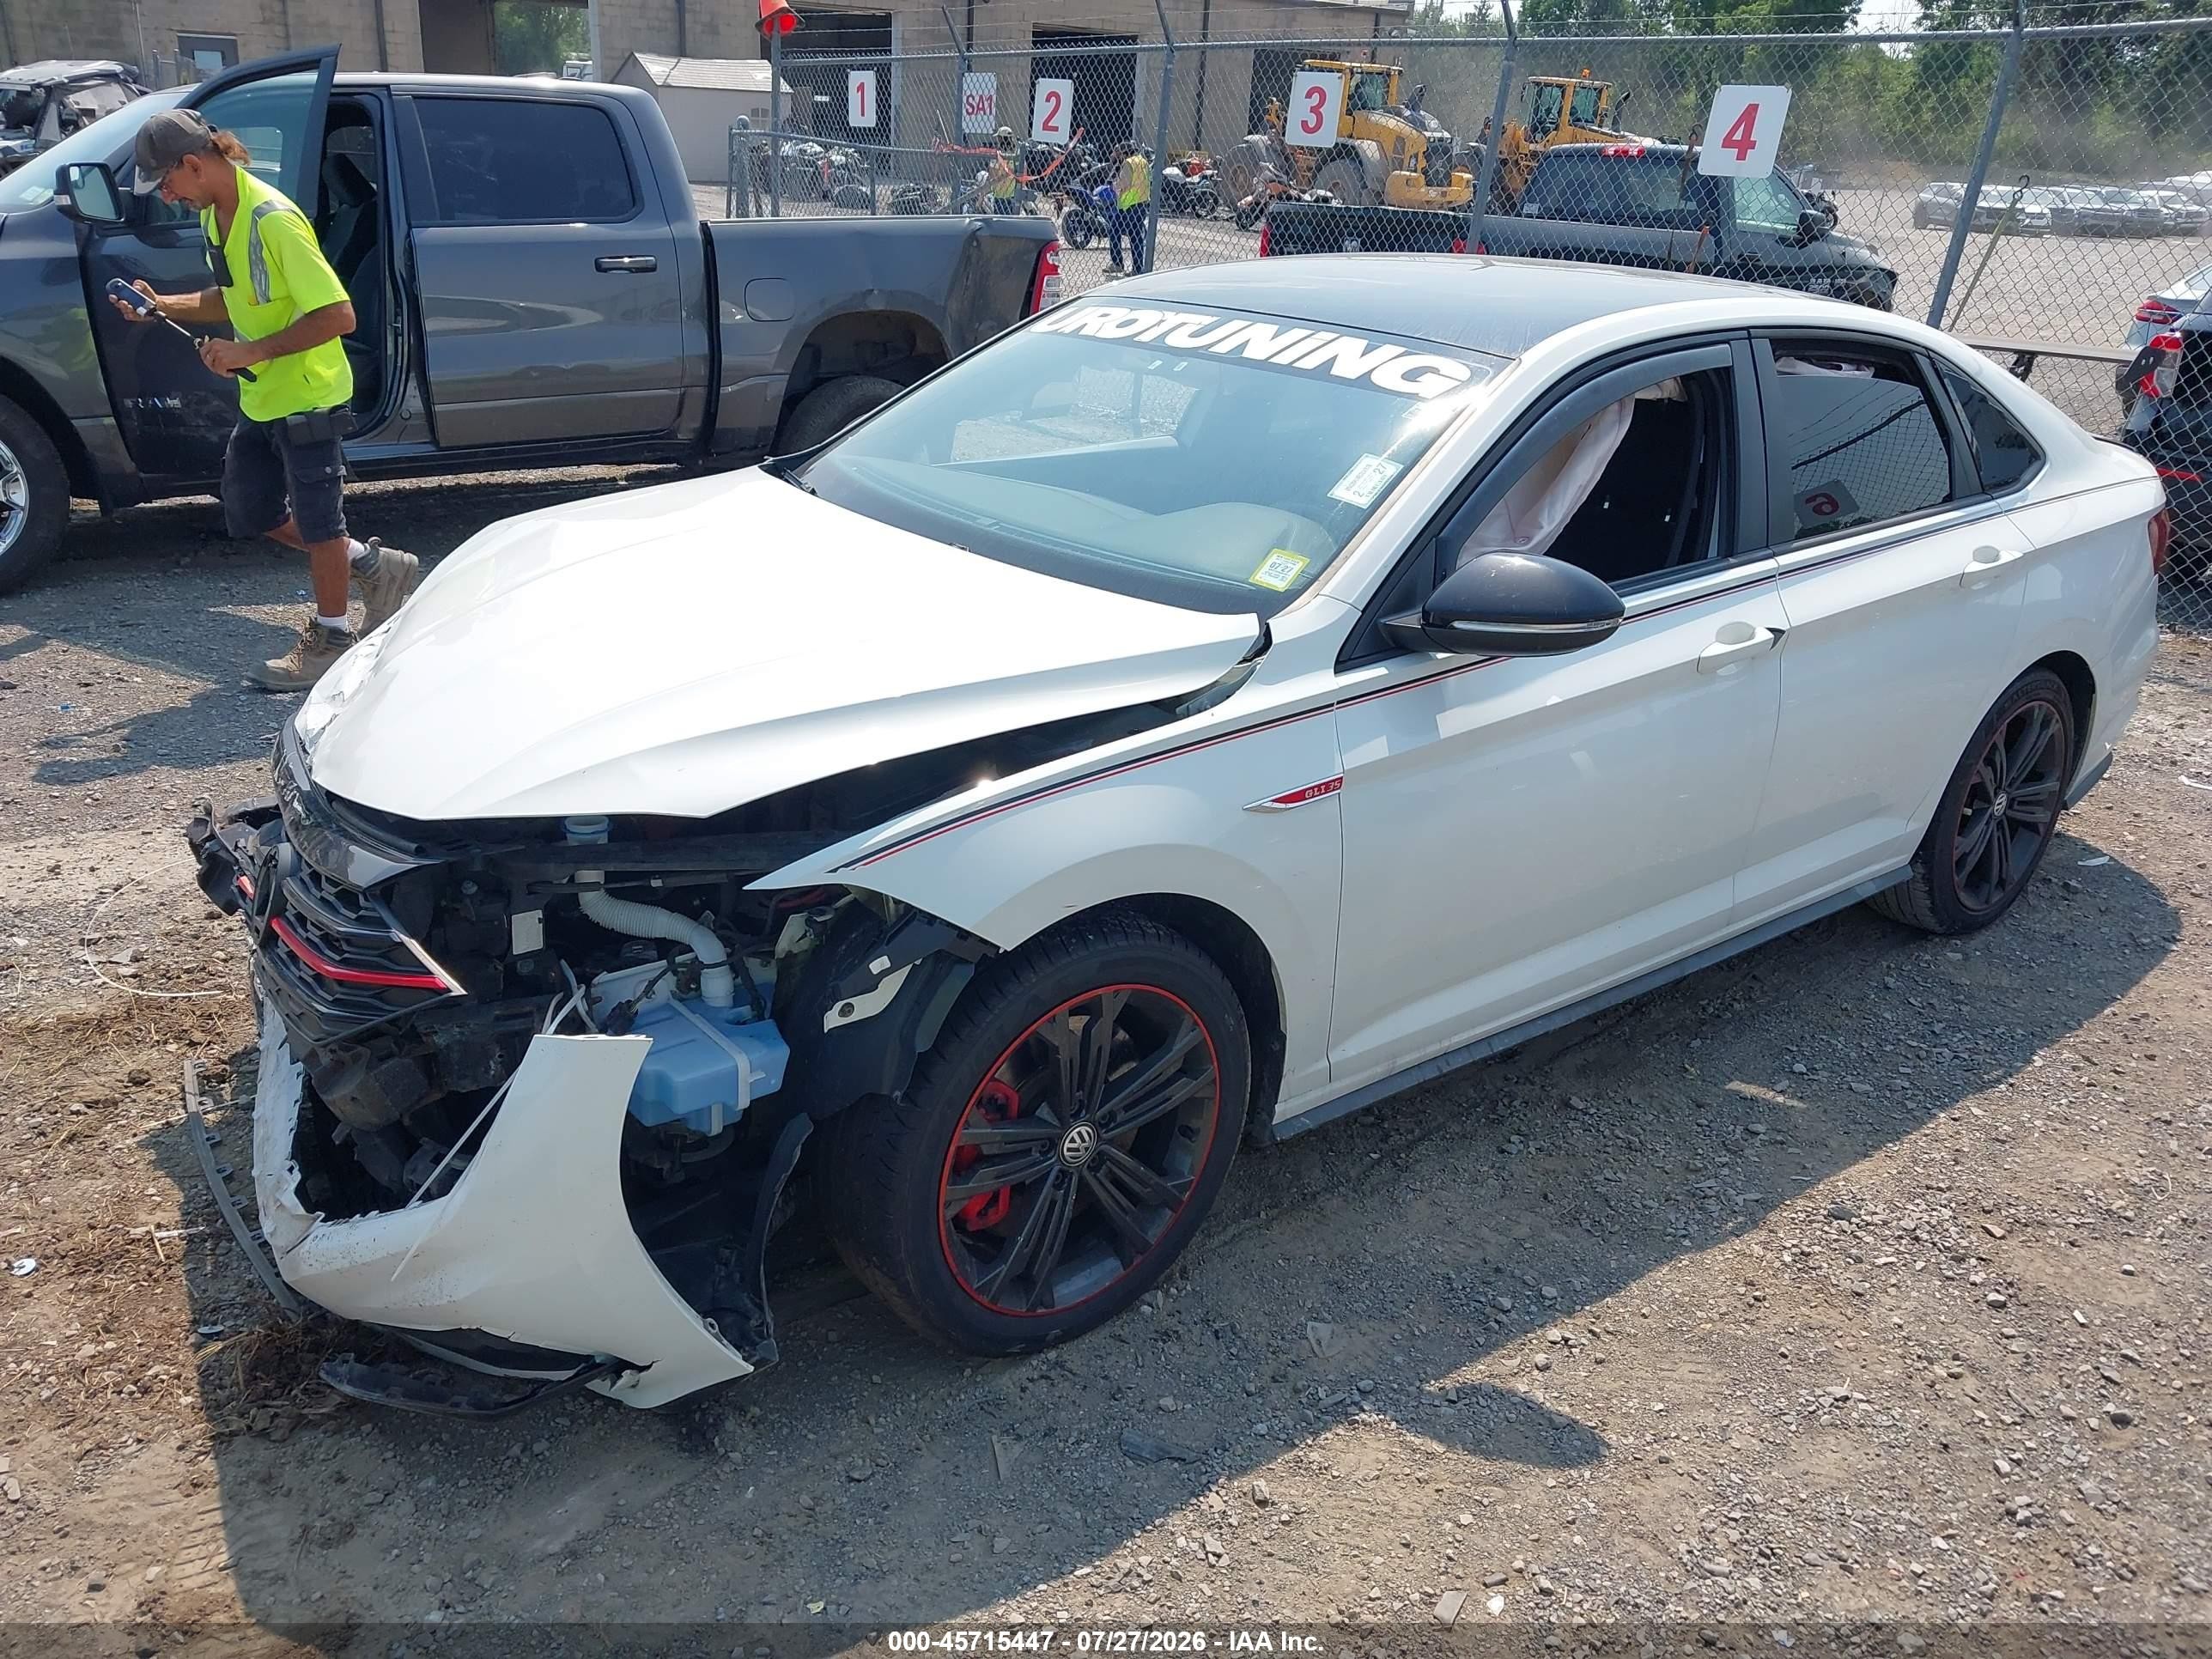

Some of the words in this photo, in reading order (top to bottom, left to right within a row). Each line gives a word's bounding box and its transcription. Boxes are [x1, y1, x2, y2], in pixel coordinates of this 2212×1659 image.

[856, 82, 866, 118] 1
[965, 94, 994, 117] SA1
[1042, 90, 1062, 133] 2
[1300, 85, 1328, 135] 3
[1721, 102, 1760, 161] 4
[1304, 784, 1326, 799] GLI
[1327, 779, 1340, 792] 35
